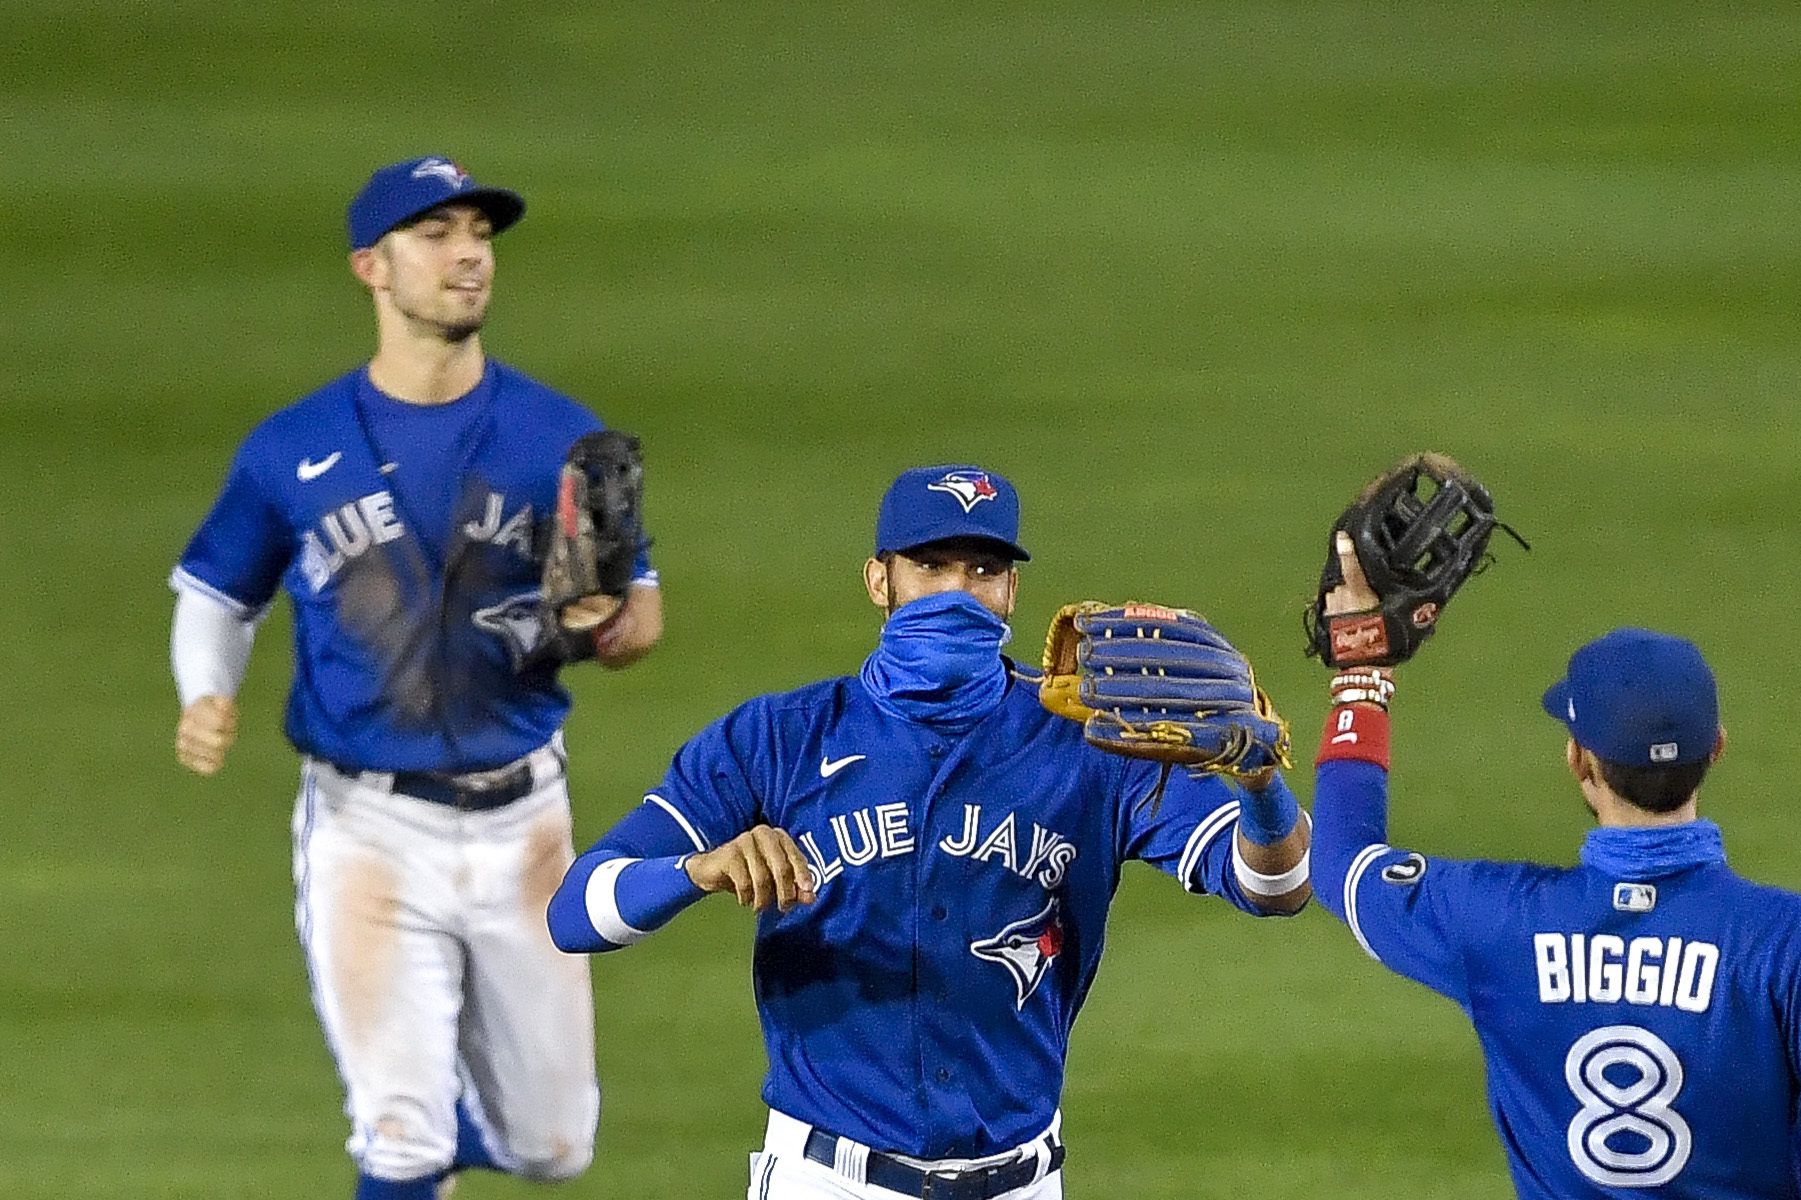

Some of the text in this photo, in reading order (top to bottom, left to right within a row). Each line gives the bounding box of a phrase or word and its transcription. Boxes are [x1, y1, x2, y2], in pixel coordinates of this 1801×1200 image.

[464, 491, 534, 560] JA
[798, 802, 1077, 893] LUE JAYS
[1533, 932, 1720, 1014] BIGGIO
[1565, 1025, 1692, 1188] 8
